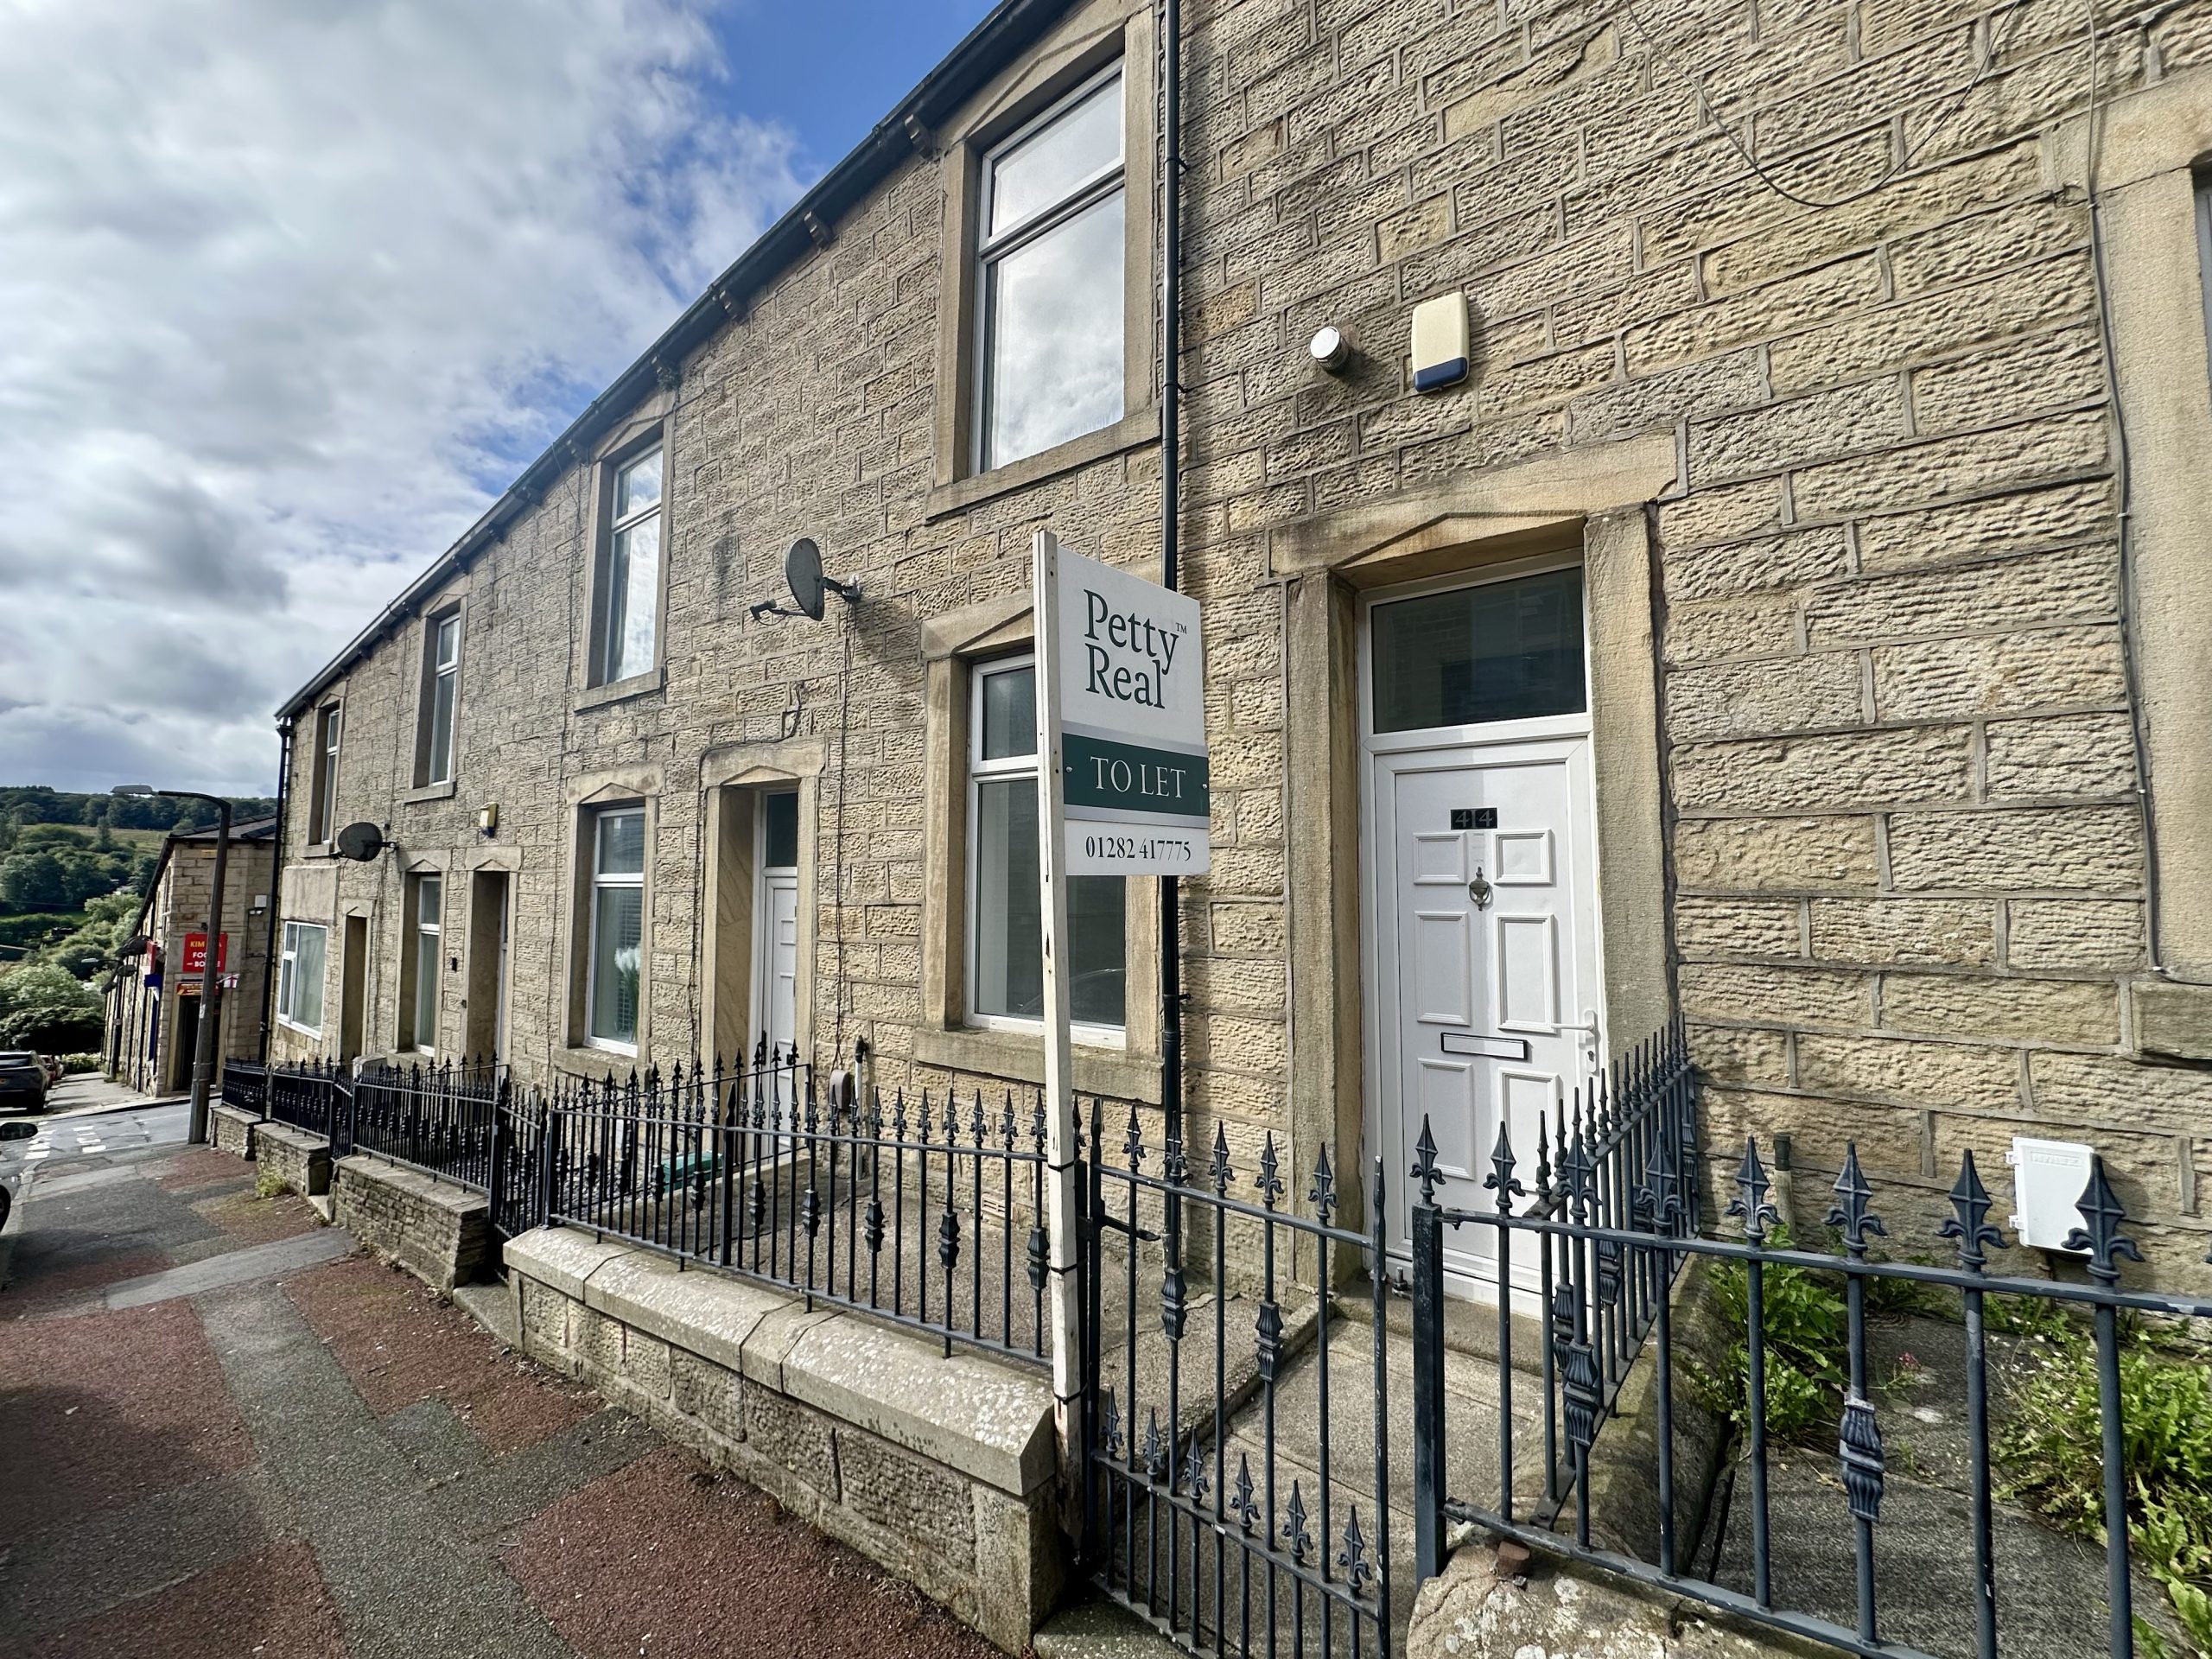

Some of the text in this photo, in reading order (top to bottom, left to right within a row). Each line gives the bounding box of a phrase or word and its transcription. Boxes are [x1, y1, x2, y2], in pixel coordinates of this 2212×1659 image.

[1083, 588, 1179, 675] Petty
[1084, 642, 1166, 709] Real
[1090, 755, 1186, 798] TO LET
[1085, 836, 1192, 861] 01282 417775
